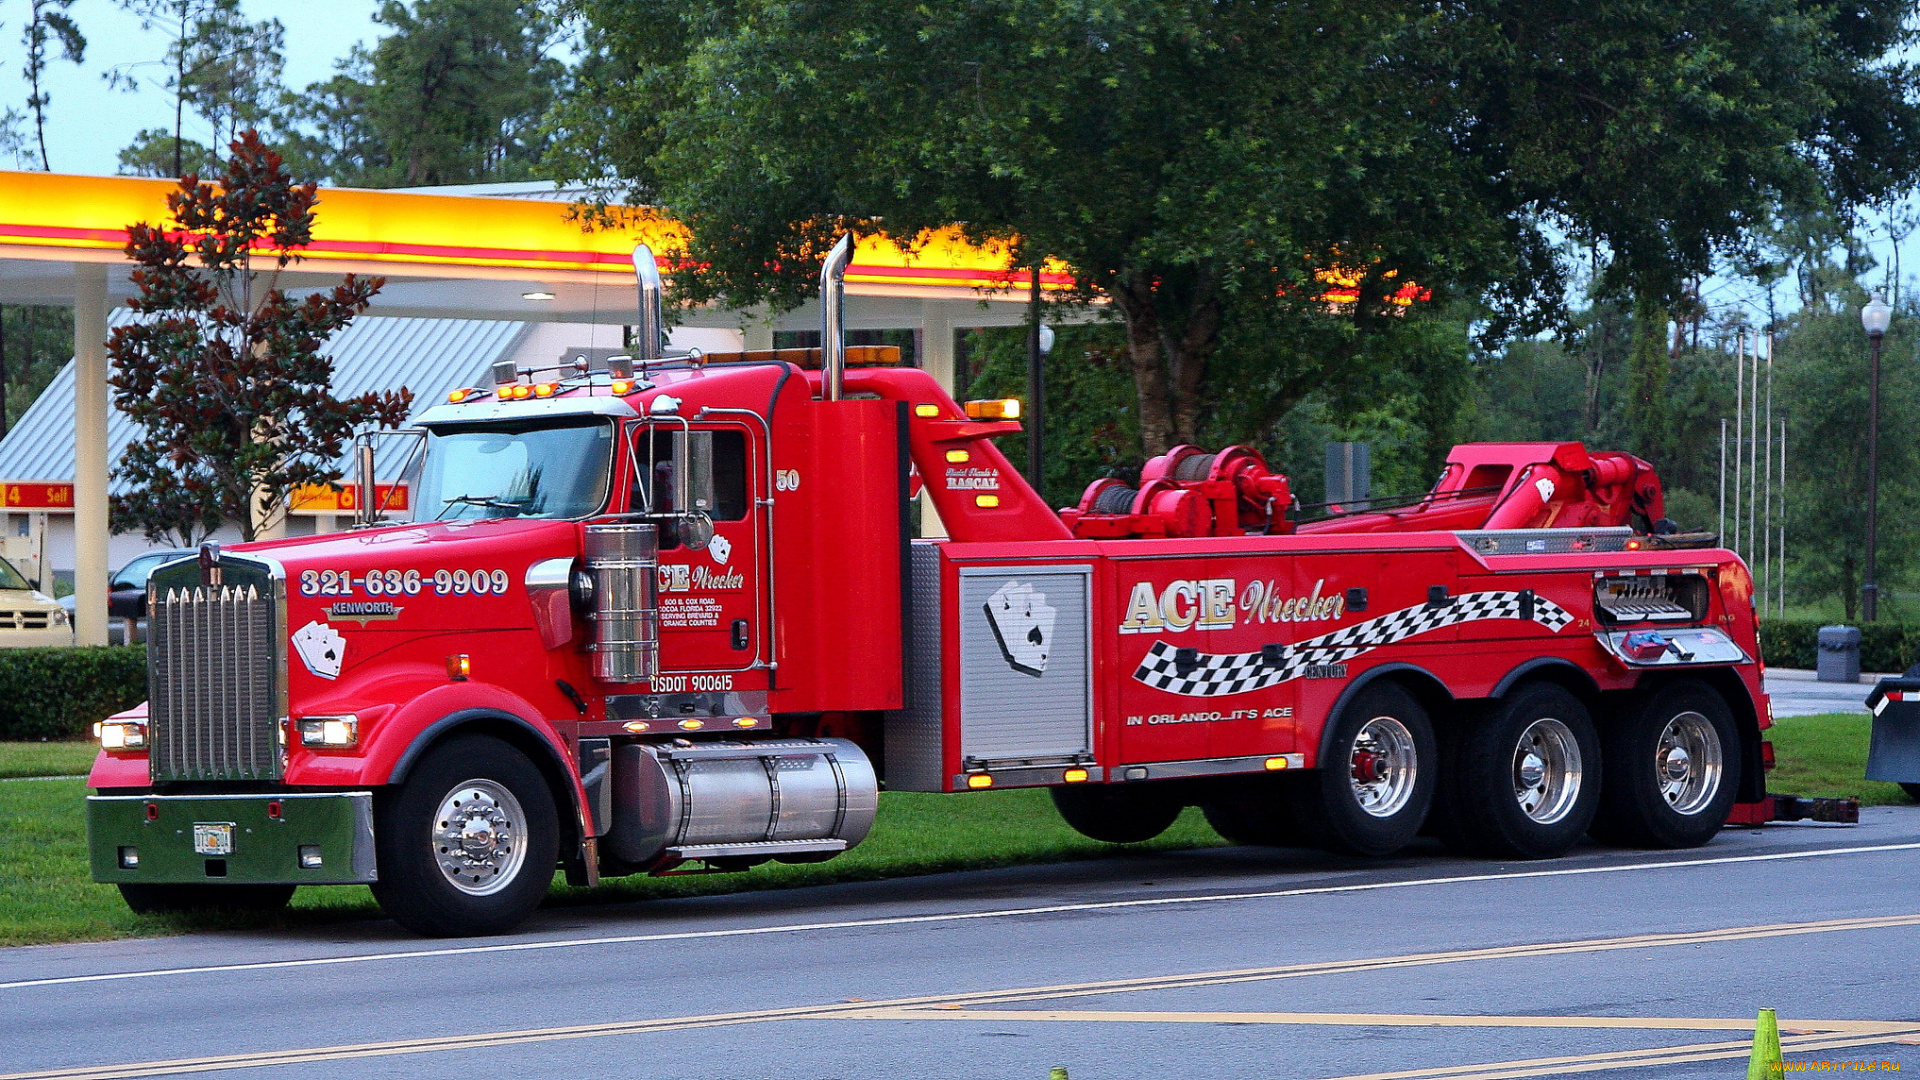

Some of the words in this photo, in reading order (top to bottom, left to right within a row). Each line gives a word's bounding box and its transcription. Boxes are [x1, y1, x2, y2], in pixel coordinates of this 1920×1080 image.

[776, 469, 799, 491] 50
[946, 477, 999, 490] RASCAL
[47, 487, 68, 503] Self
[340, 487, 354, 506] 6
[300, 569, 509, 597] 321-636-9909
[658, 564, 690, 592] CE
[691, 565, 744, 590] Wrecker
[332, 602, 394, 615] KENWORTH
[1119, 578, 1236, 634] ACE
[1240, 578, 1345, 624] Wrecker
[1578, 619, 1590, 628] 24
[1305, 663, 1348, 679] CENTURY
[651, 676, 688, 692] USDOT
[691, 675, 733, 691] 900615
[1127, 715, 1143, 726] IN
[1262, 707, 1293, 719] ACE
